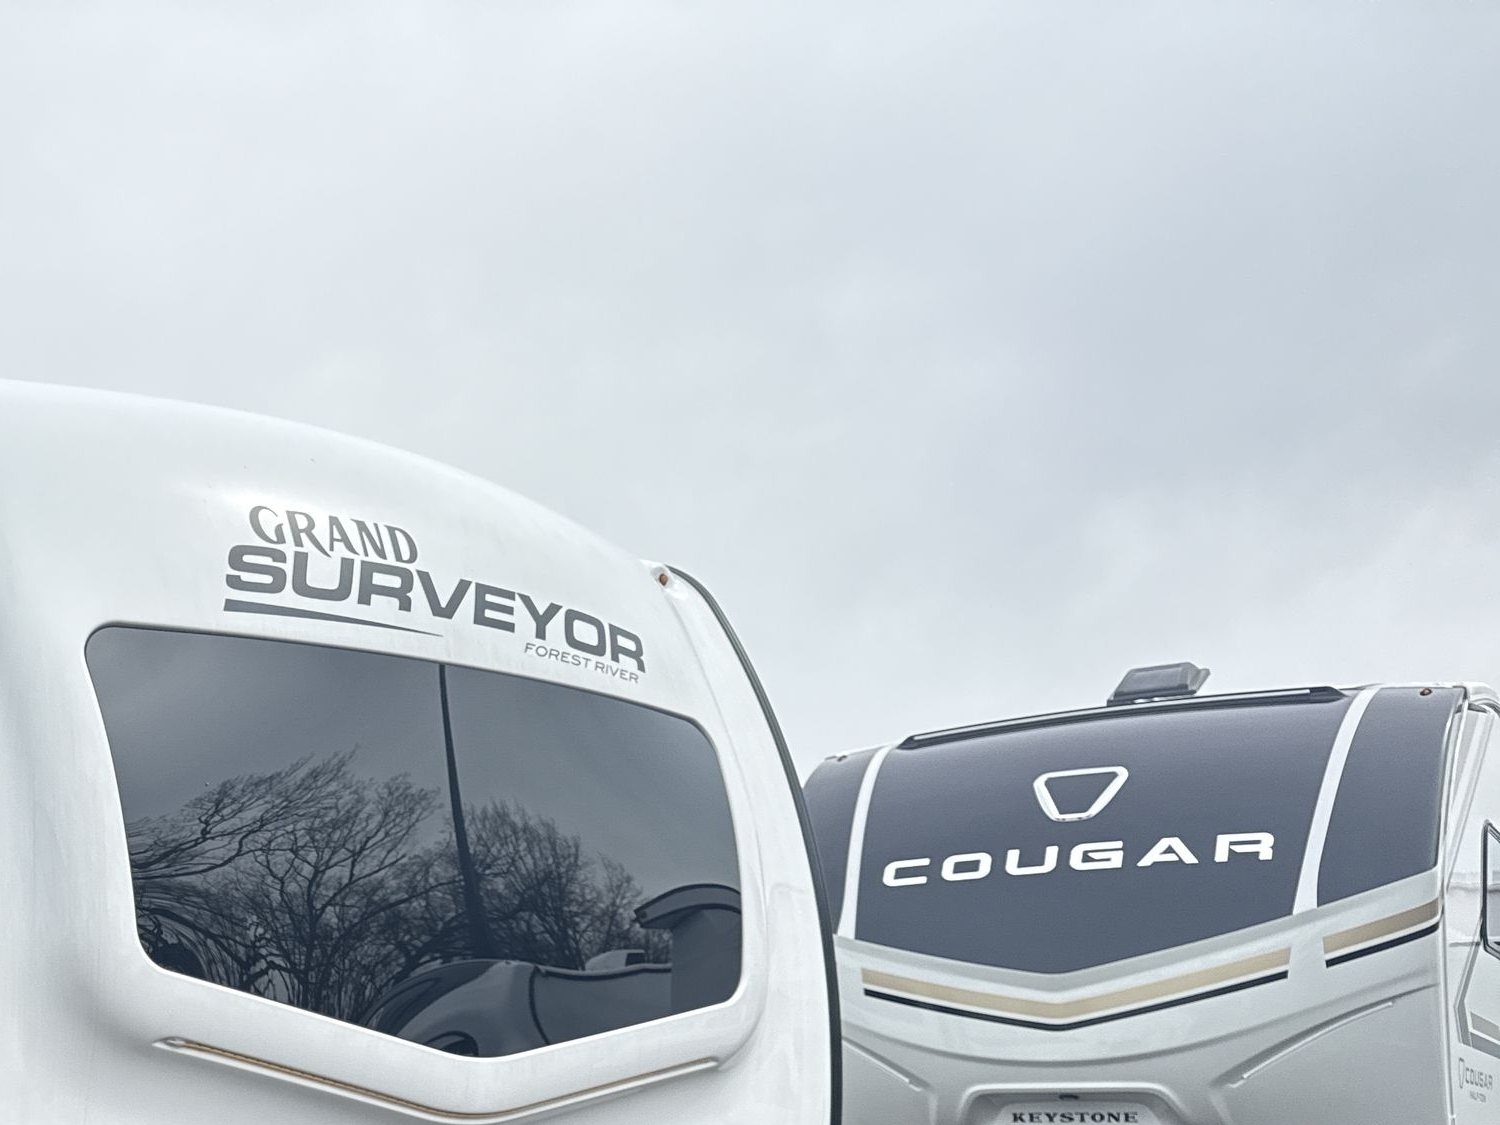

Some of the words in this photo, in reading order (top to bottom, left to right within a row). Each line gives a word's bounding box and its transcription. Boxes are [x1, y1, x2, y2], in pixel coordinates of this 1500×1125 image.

[248, 505, 419, 565] GRAND
[225, 544, 646, 673] SURVEYOR
[524, 643, 591, 669] FOREST
[594, 661, 639, 684] RIVER
[882, 831, 1275, 888] COUGAR
[1011, 1111, 1139, 1124] KEYSTONE
